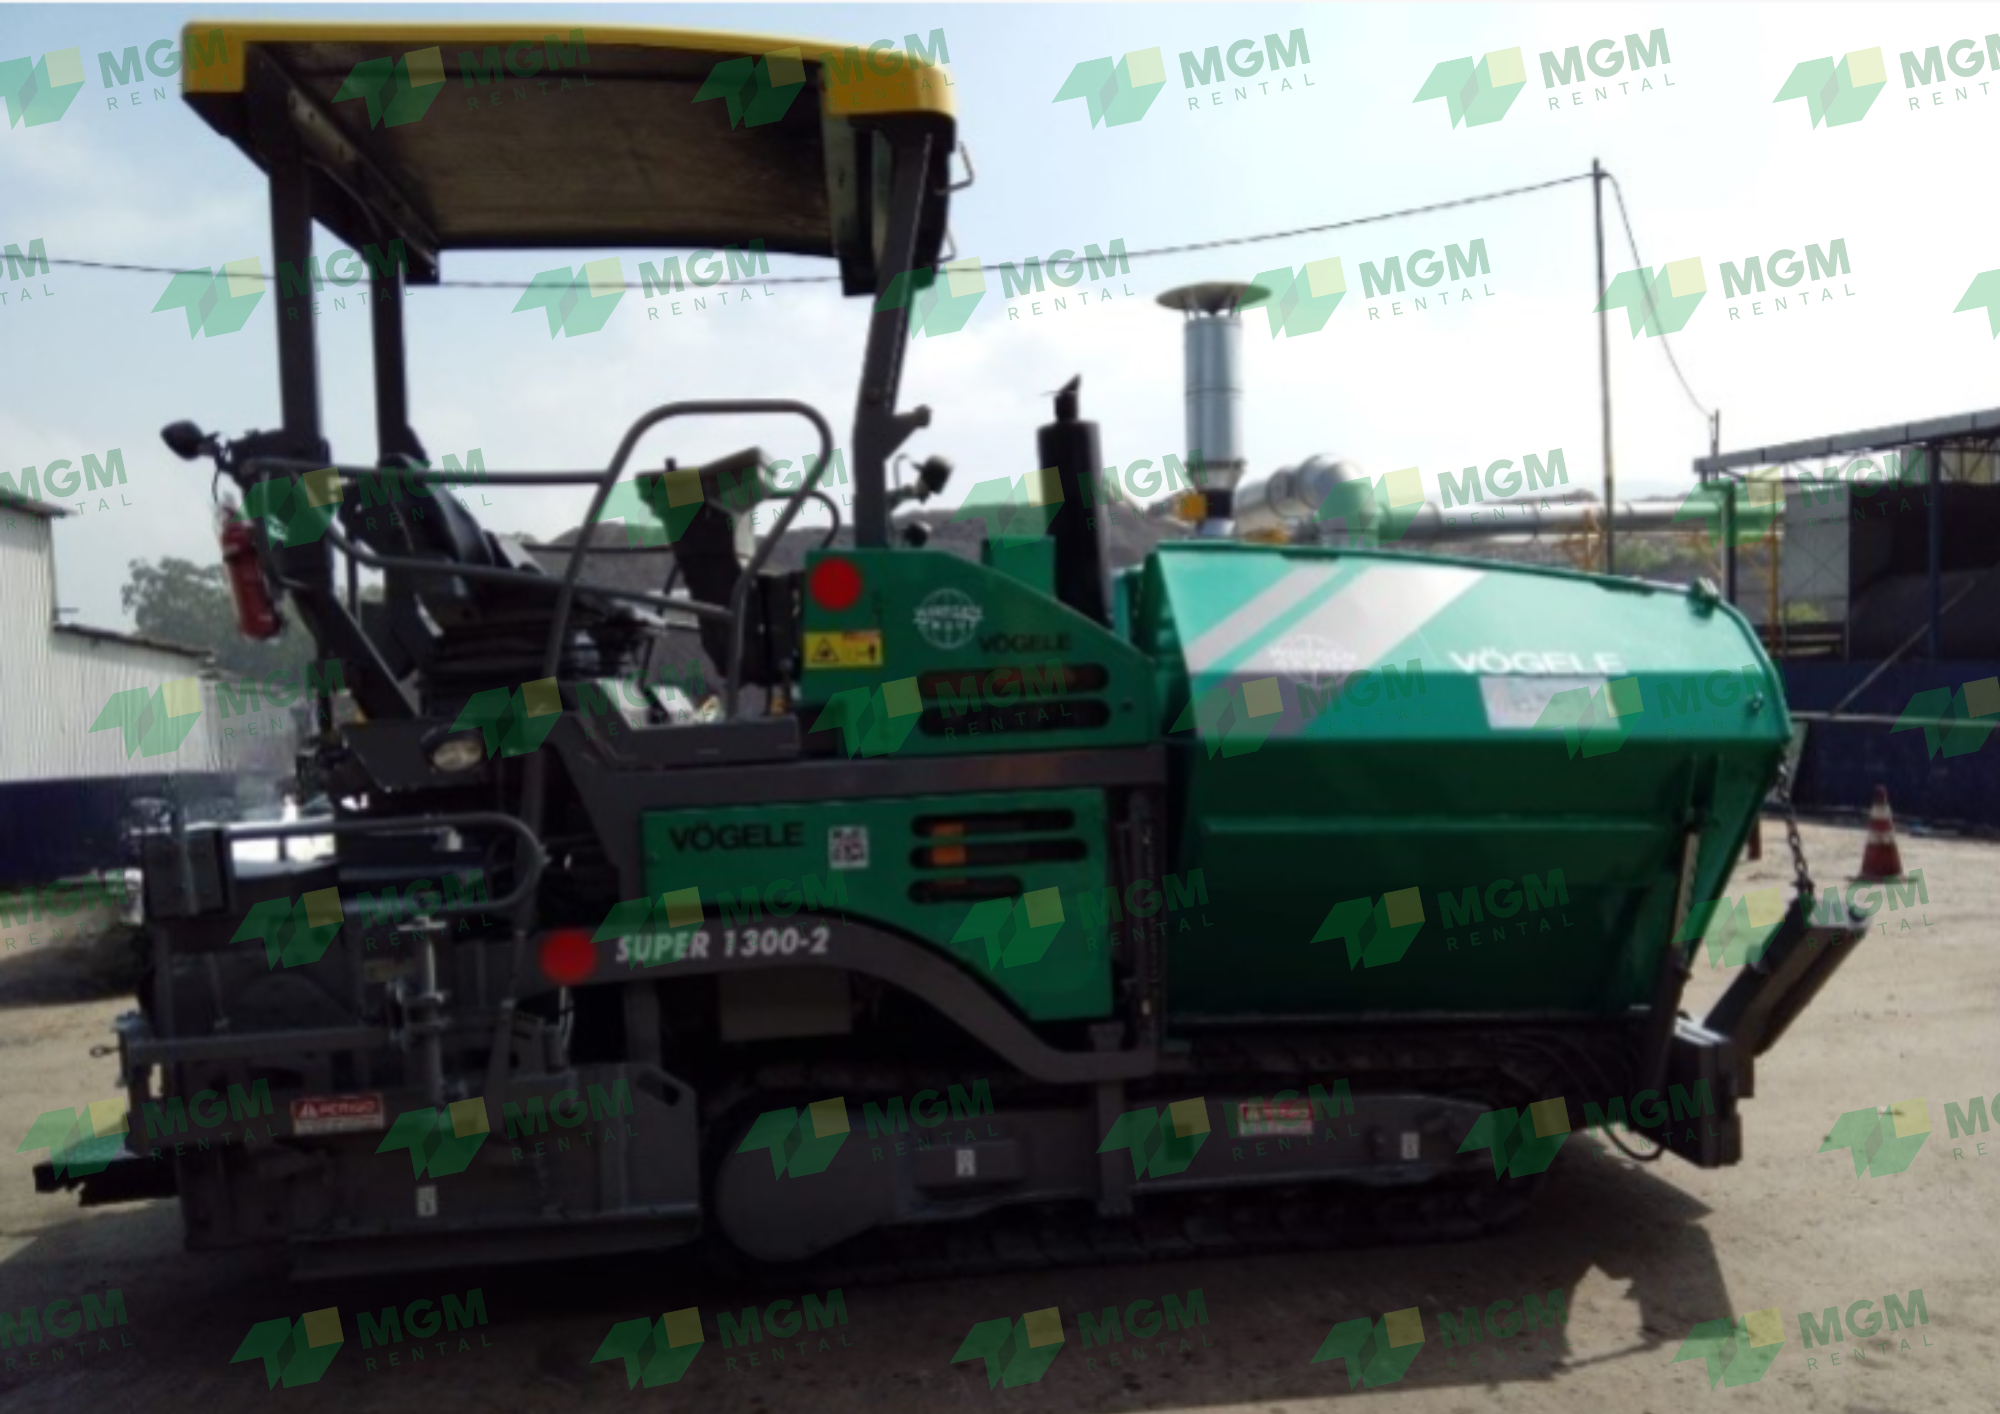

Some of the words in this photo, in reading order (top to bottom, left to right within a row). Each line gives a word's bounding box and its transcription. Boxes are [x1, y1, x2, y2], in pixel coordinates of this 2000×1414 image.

[670, 821, 803, 852] VÖGELE
[616, 932, 709, 961] SUPER
[725, 926, 829, 957] 1300-2
